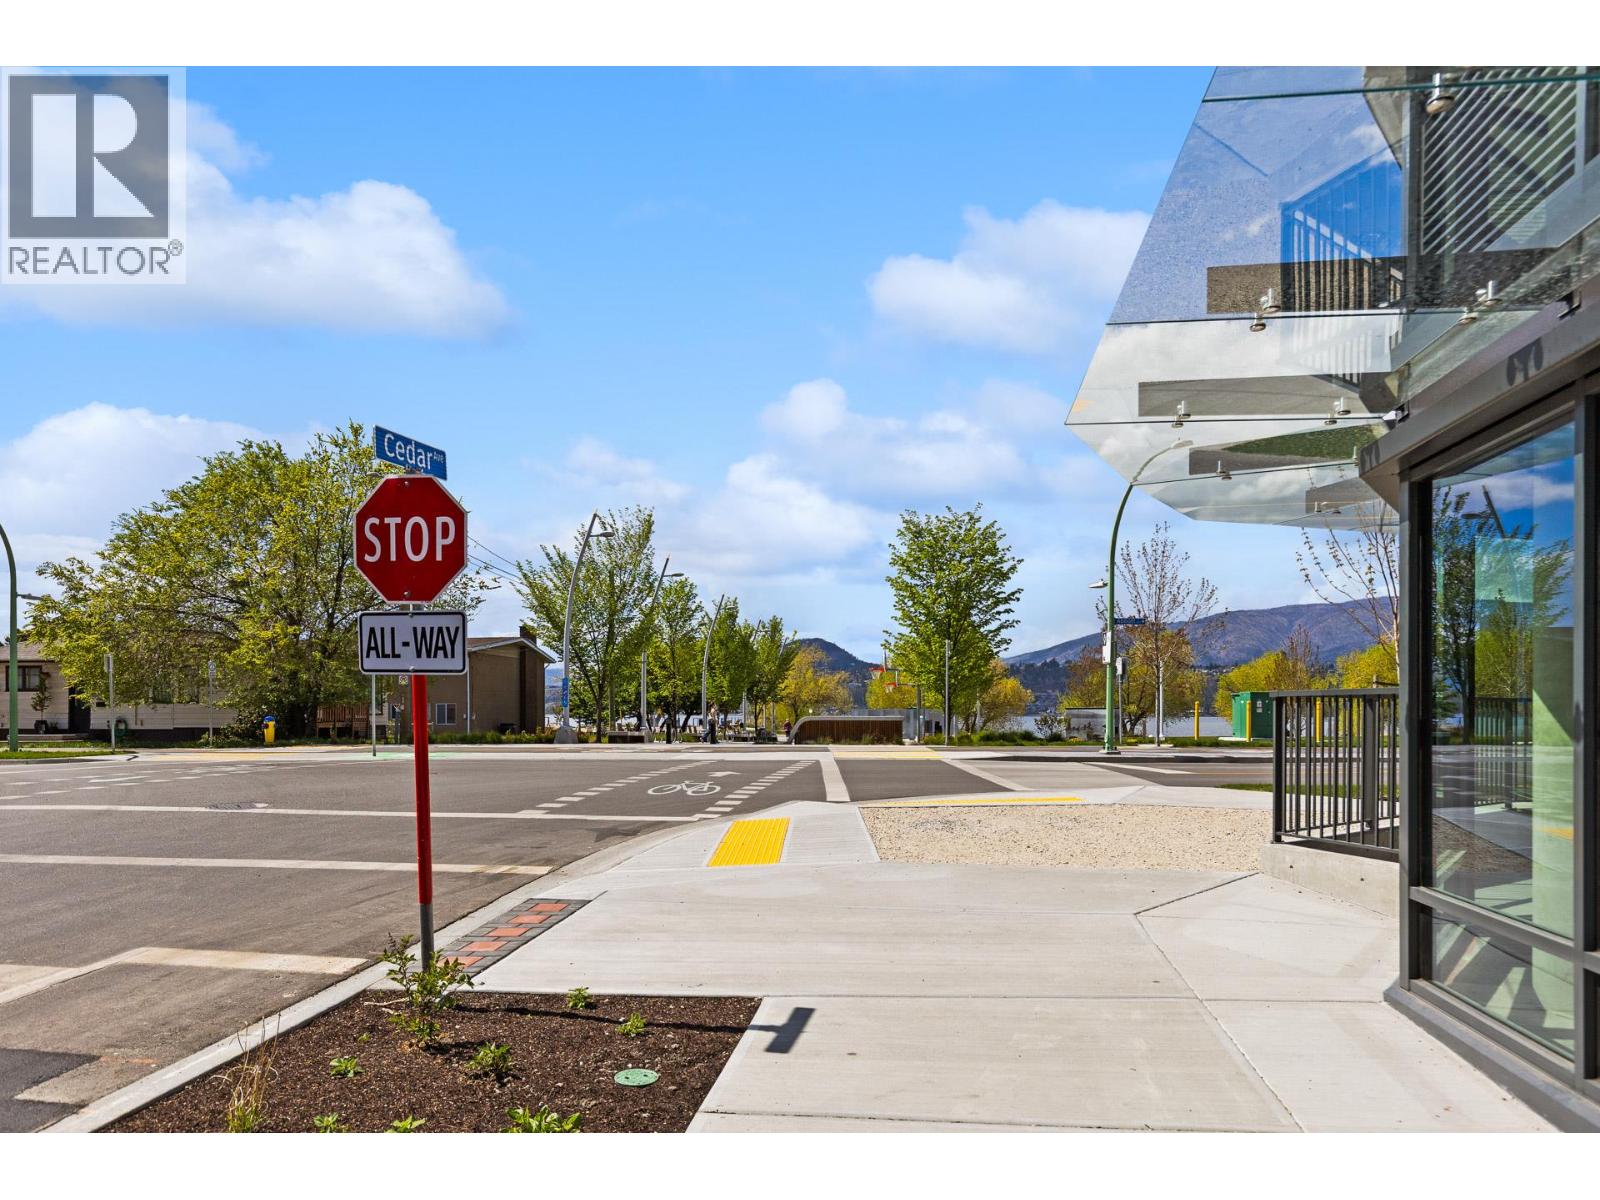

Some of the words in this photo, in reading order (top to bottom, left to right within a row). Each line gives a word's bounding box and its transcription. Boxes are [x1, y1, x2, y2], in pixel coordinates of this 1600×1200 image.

[384, 433, 432, 470] Cedar
[433, 450, 444, 464] Ave
[364, 516, 456, 562] STOP
[366, 626, 460, 659] ALL-WAY
